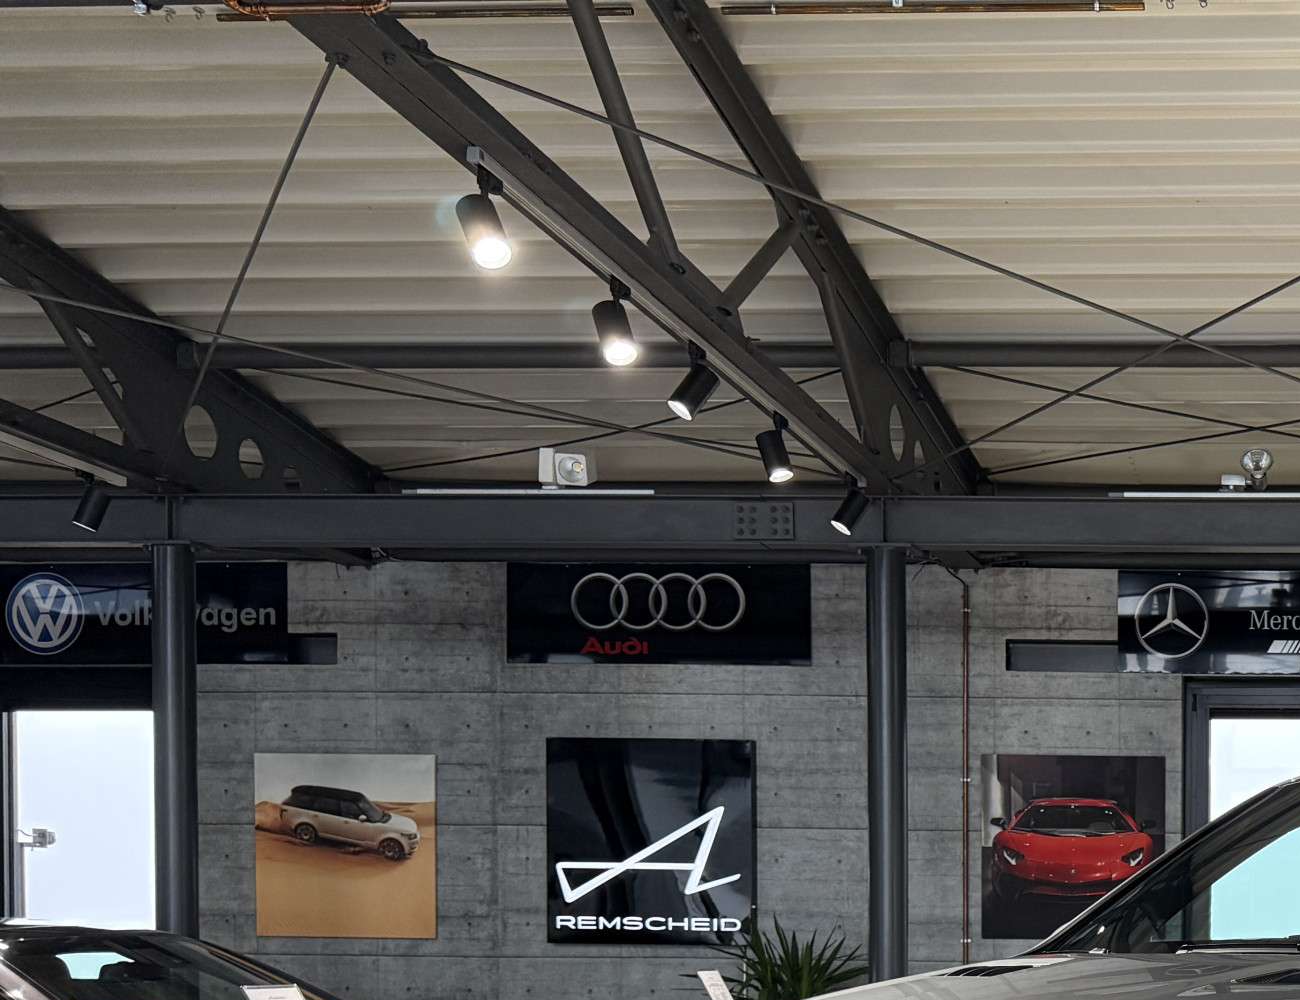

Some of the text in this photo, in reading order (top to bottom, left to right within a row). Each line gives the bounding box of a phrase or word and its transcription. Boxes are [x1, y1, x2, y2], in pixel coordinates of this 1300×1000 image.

[94, 600, 277, 633] Volkagen
[580, 637, 649, 655] Audi
[555, 915, 742, 932] REMSCHEID
